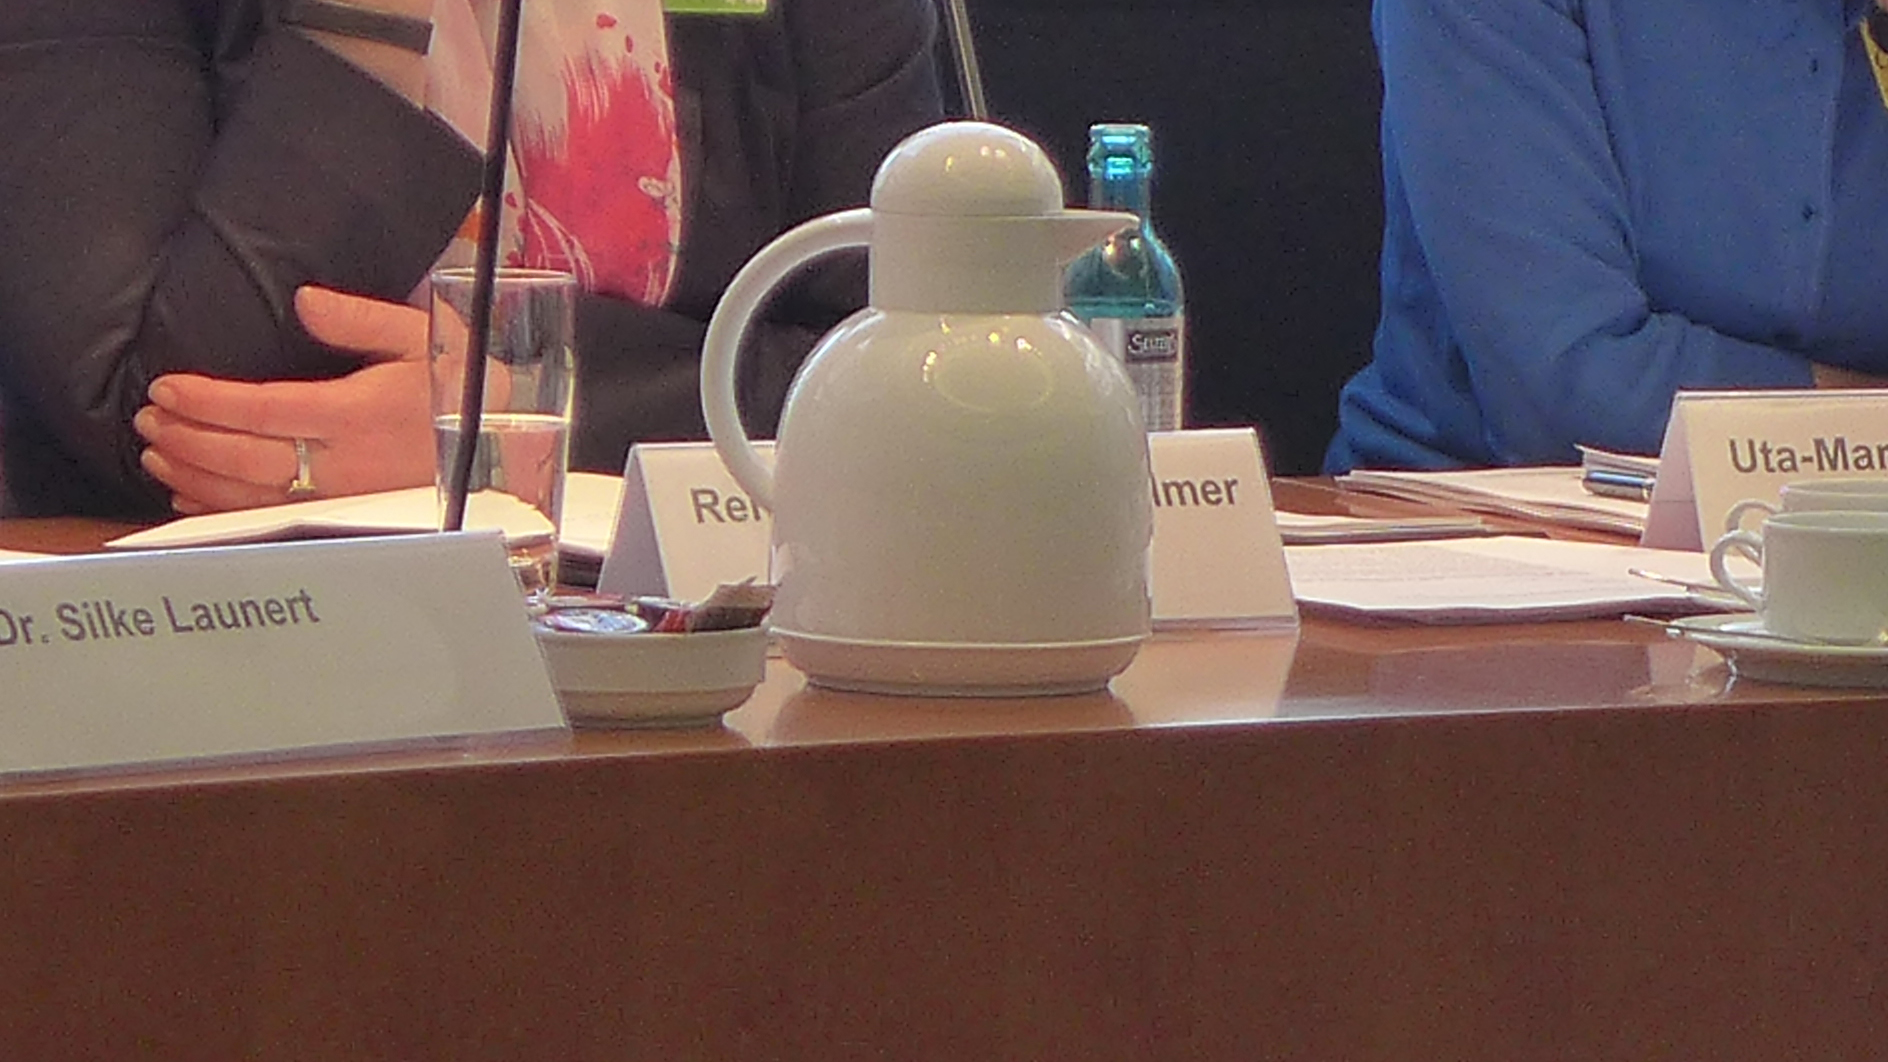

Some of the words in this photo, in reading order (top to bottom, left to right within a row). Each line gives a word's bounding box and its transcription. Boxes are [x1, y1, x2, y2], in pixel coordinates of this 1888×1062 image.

[1150, 474, 1239, 507] lmer
[56, 600, 155, 642] Silke
[162, 588, 321, 634] Launert
